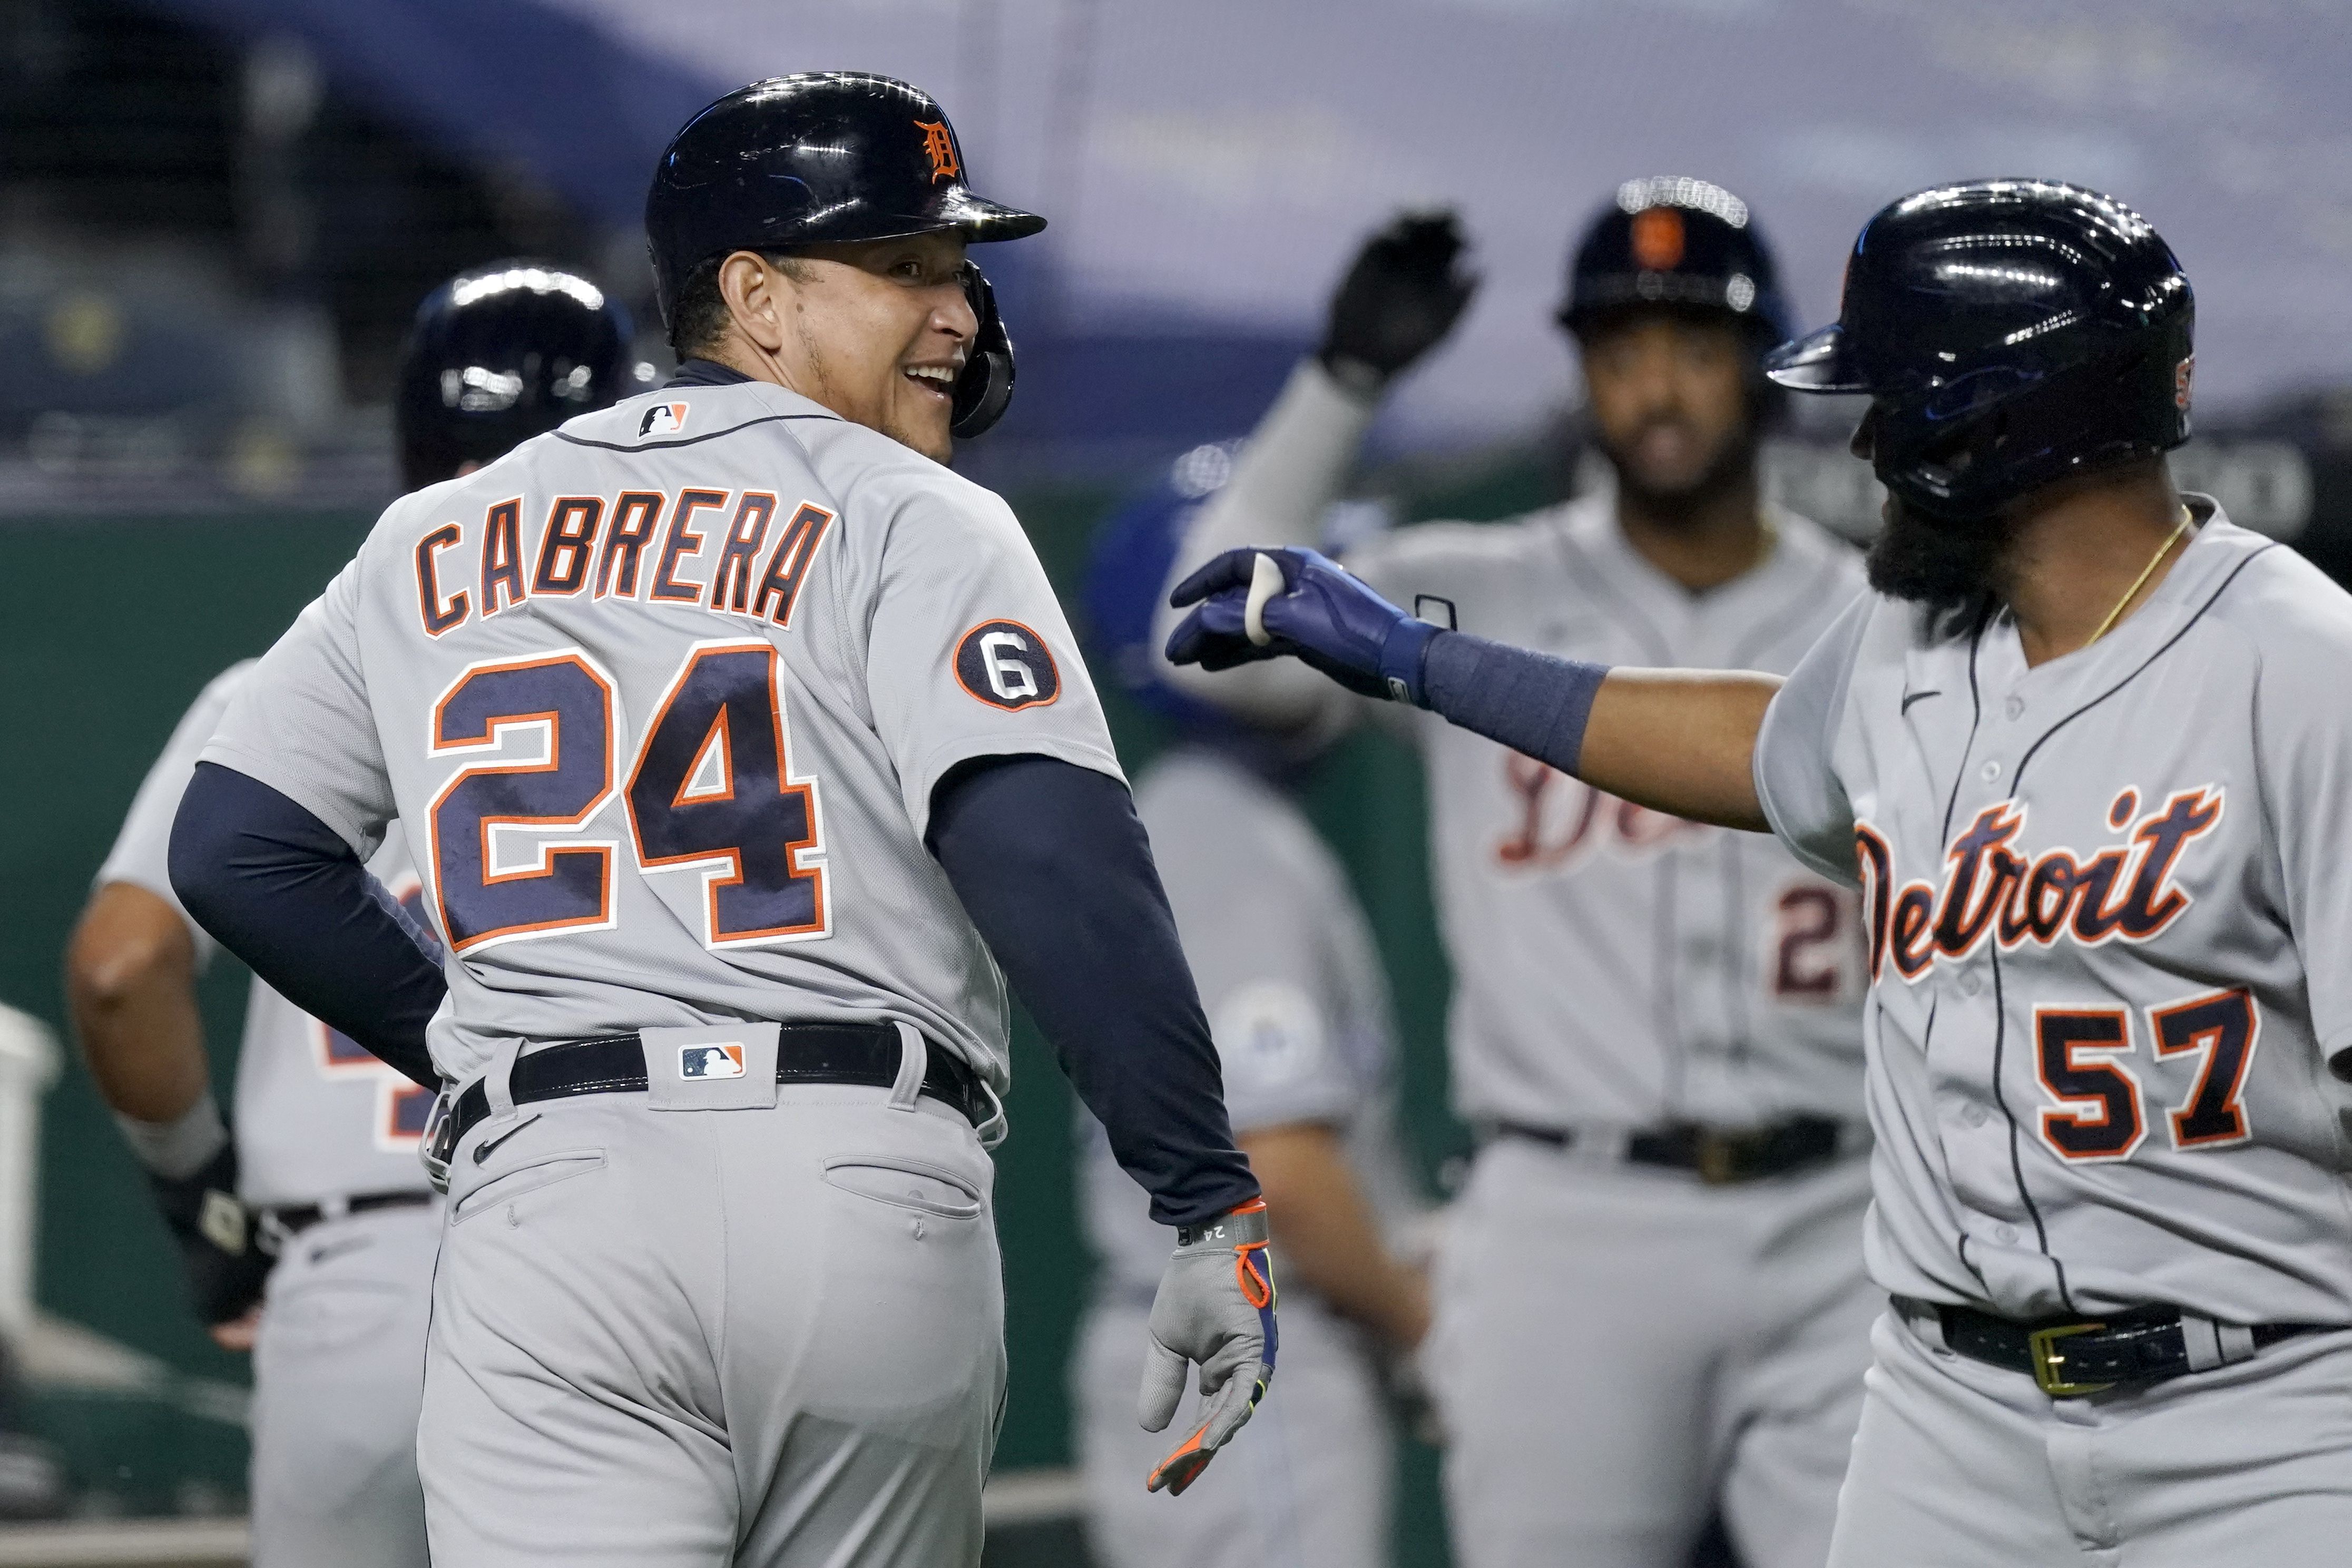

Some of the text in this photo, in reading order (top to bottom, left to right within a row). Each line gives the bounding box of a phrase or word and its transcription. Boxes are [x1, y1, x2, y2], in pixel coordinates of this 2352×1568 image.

[914, 120, 959, 184] D
[413, 486, 838, 641] CABRERA
[979, 631, 1039, 700] 6
[424, 636, 833, 959] 24
[2031, 984, 2261, 1164] 57
[1203, 1225, 1225, 1242] 24
